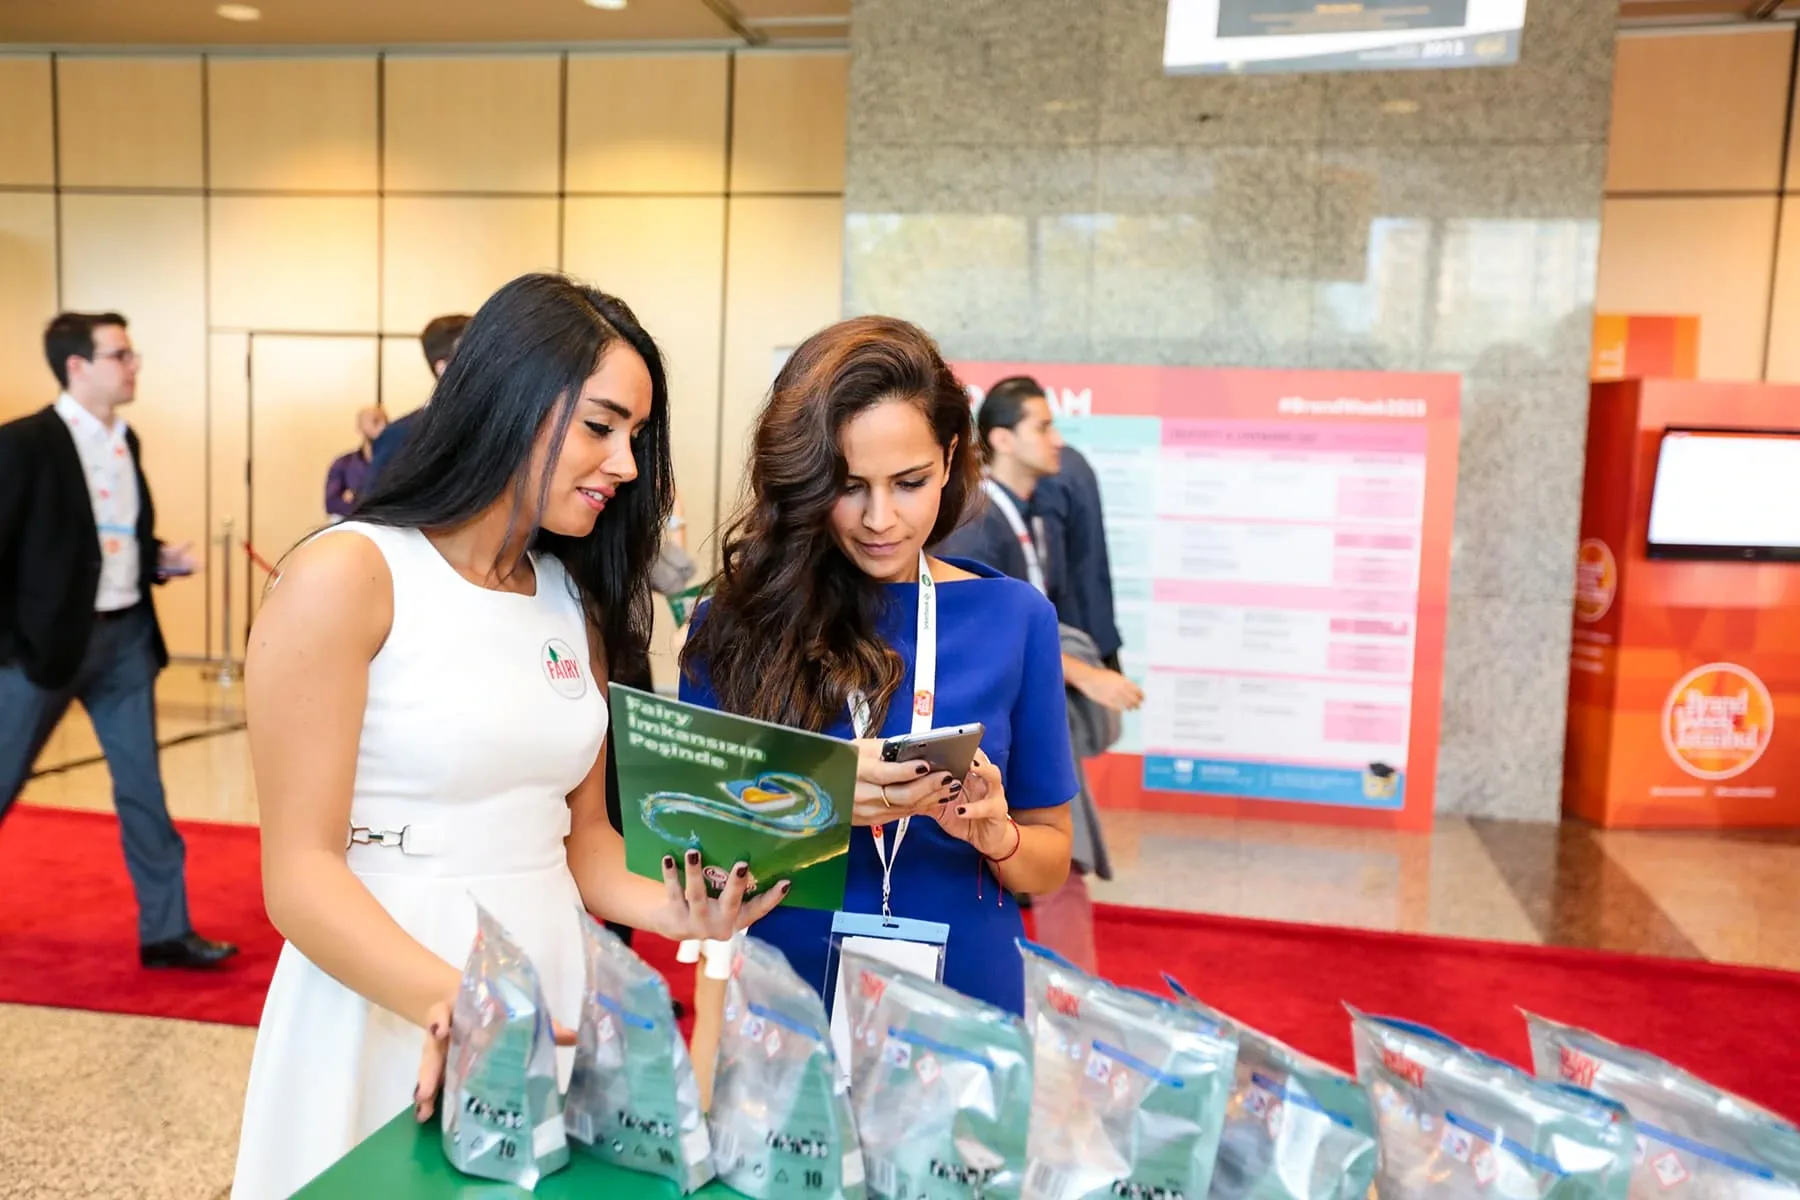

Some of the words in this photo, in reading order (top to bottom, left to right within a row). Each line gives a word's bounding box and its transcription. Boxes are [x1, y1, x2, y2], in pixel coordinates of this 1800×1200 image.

[546, 659, 580, 680] FAIRY
[625, 695, 693, 729] Fairy
[803, 1168, 823, 1190] 10
